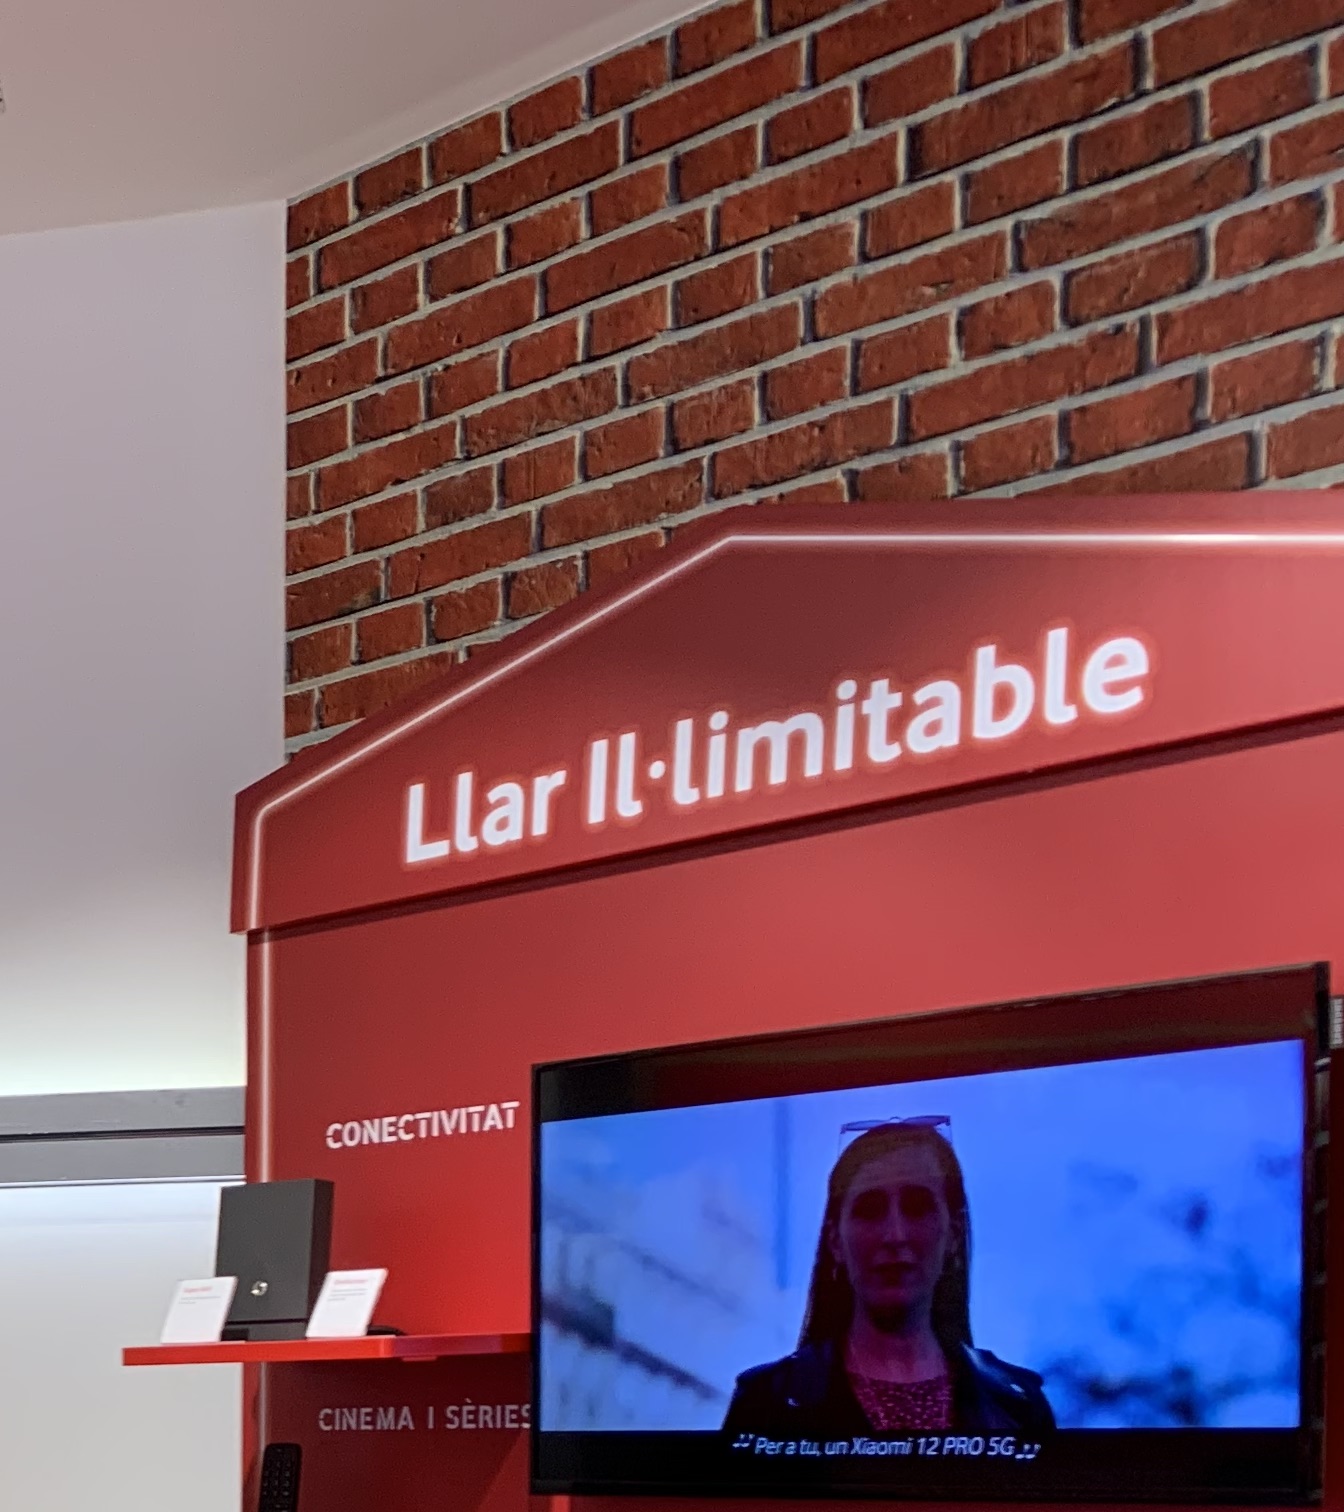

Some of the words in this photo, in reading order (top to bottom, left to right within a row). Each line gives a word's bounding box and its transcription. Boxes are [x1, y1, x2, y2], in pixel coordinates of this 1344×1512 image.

[404, 768, 568, 866] Llar
[325, 1101, 521, 1150] CONECTIVITAT
[318, 1406, 415, 1432] CINEMA
[426, 1406, 435, 1430] I
[445, 1398, 531, 1430] SÈRIES
[754, 1437, 784, 1455] Per
[784, 1441, 797, 1455] a
[824, 1441, 849, 1455] un
[850, 1436, 914, 1455] Xiaomi
[917, 1436, 941, 1455] 12
[942, 1436, 986, 1456] PRO
[987, 1436, 1016, 1456] 5G
